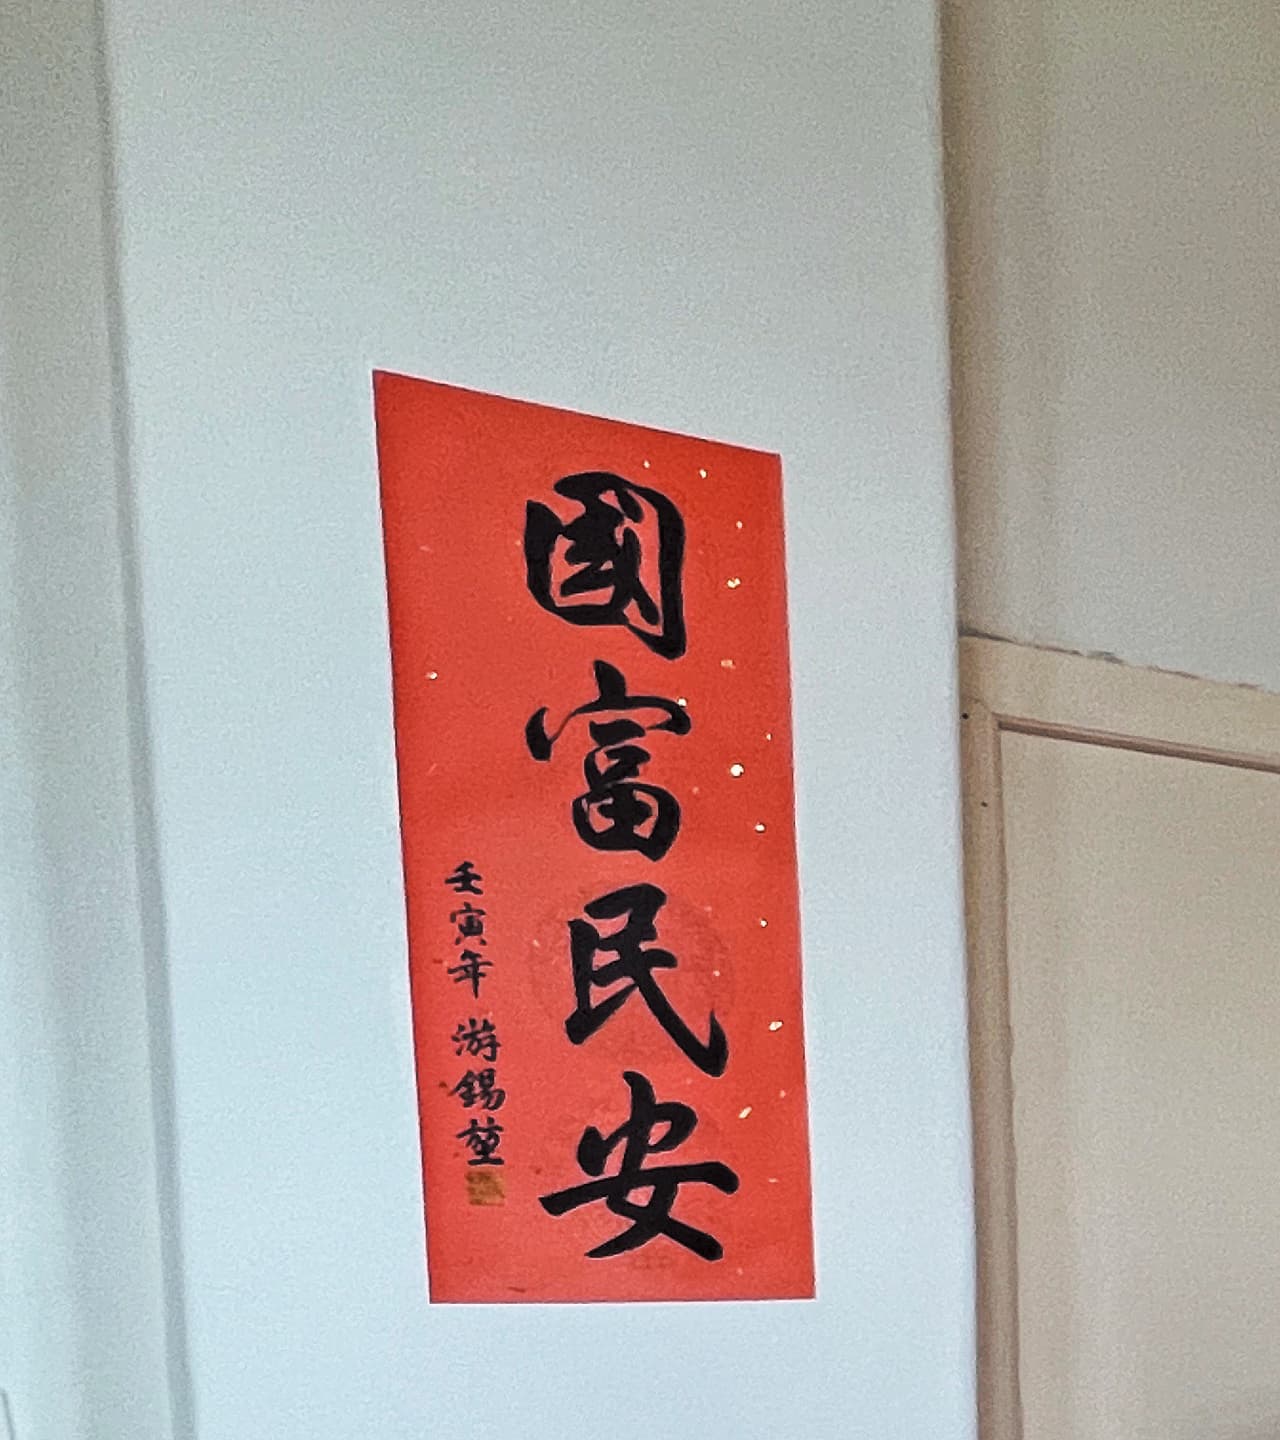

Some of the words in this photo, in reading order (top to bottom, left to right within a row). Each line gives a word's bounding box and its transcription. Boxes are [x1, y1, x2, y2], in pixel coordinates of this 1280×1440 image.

[445, 861, 494, 1000] 壬寅年
[524, 472, 738, 1261] 國富民安
